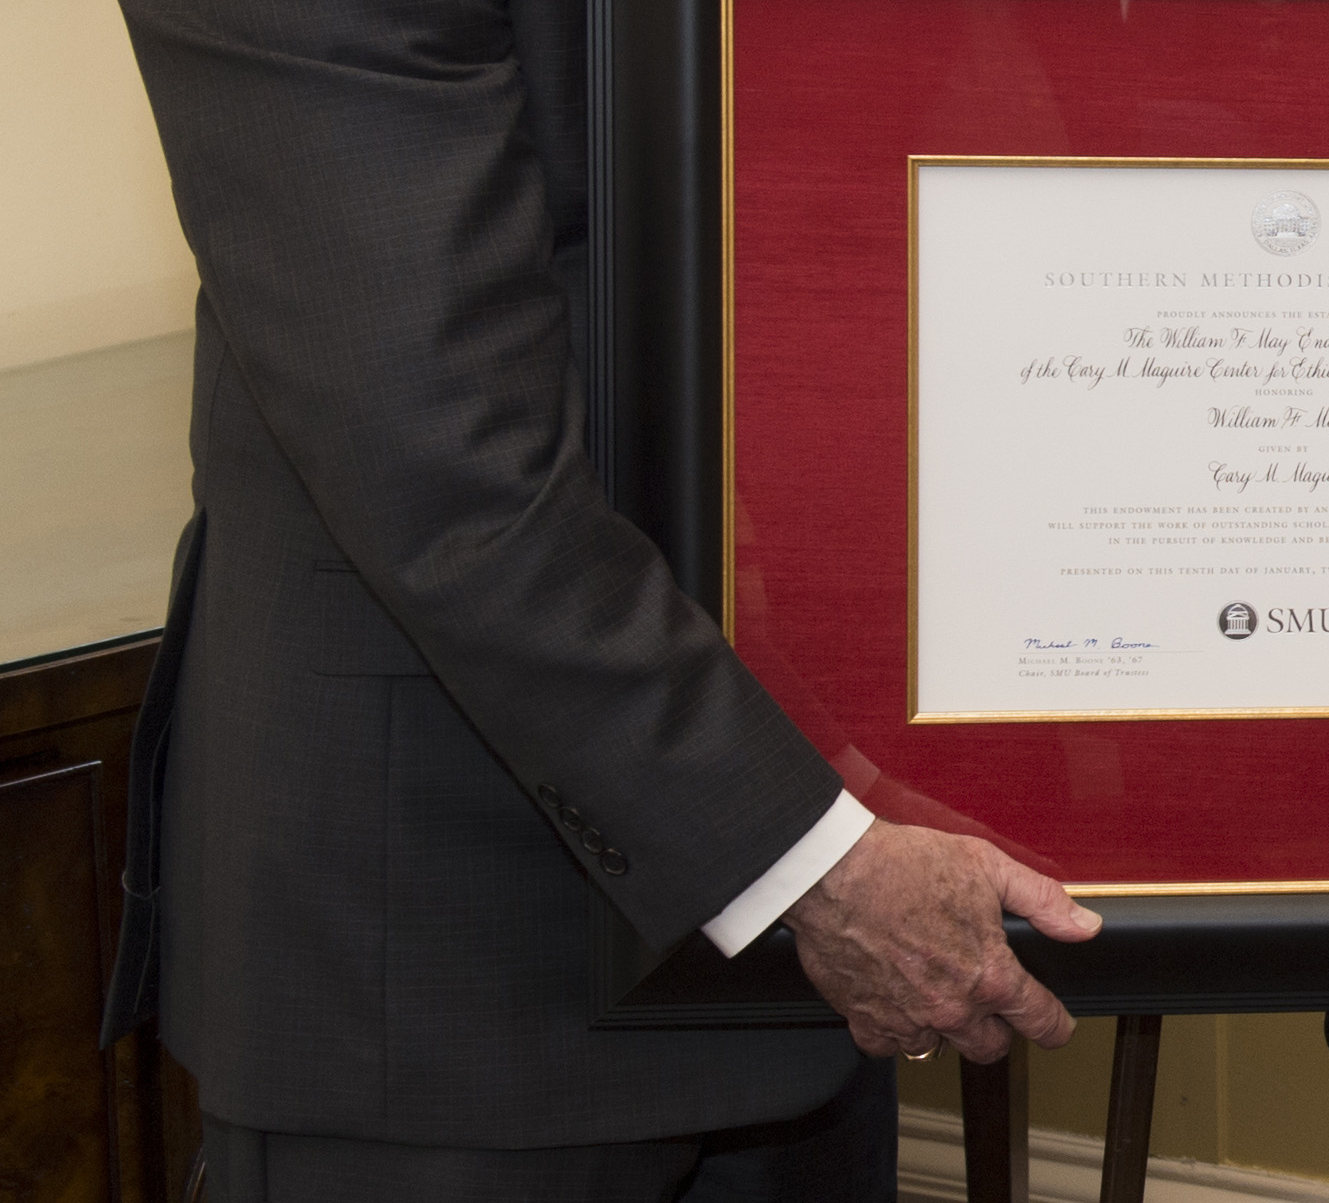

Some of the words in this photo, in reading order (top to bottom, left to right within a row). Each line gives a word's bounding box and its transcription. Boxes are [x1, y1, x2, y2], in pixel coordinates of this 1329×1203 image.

[1044, 272, 1187, 288] SOUTHERN
[1124, 325, 1154, 348] The
[1159, 326, 1225, 348] William
[1248, 327, 1291, 356] May
[1021, 360, 1037, 384] of
[1036, 357, 1061, 378] the
[1063, 355, 1107, 390] Cary
[1131, 357, 1204, 388] Maguire
[1206, 358, 1262, 383] Center
[1262, 361, 1287, 386] for
[1208, 405, 1278, 428] William
[1208, 461, 1257, 493] Cary
[1244, 506, 1292, 514] CREATED
[1079, 522, 1126, 530] SUPPORT
[1125, 537, 1146, 545] THE
[1291, 536, 1313, 544] AND
[1060, 568, 1122, 576] PRESENTED
[1179, 567, 1214, 575] TENTH
[1220, 567, 1240, 575] DAY
[1246, 567, 1259, 575] OF
[1264, 567, 1316, 575] JANUARY,
